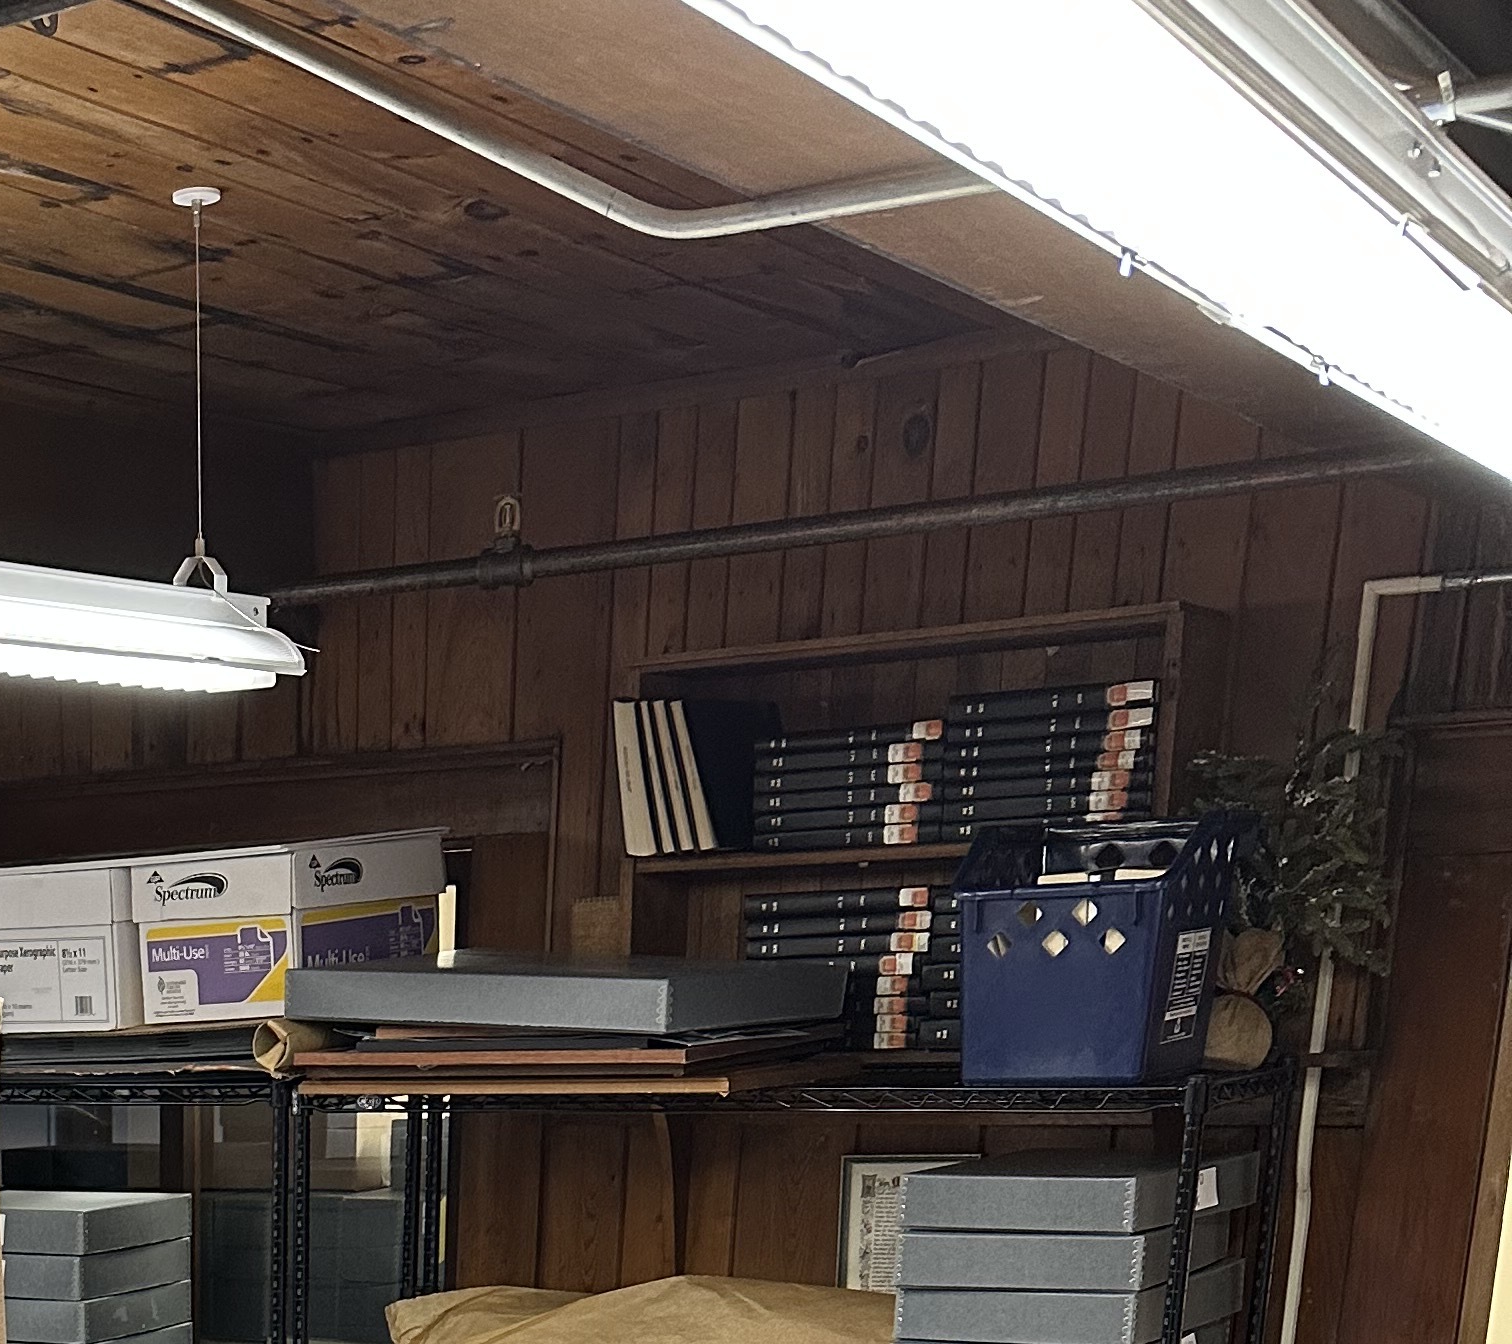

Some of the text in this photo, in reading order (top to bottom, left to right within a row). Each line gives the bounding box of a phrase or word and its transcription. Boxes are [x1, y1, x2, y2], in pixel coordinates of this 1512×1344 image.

[314, 870, 357, 893] Spectrum
[154, 885, 217, 907] Spectrum
[152, 945, 205, 963] Multi-Use
[307, 949, 365, 968] MultiUse
